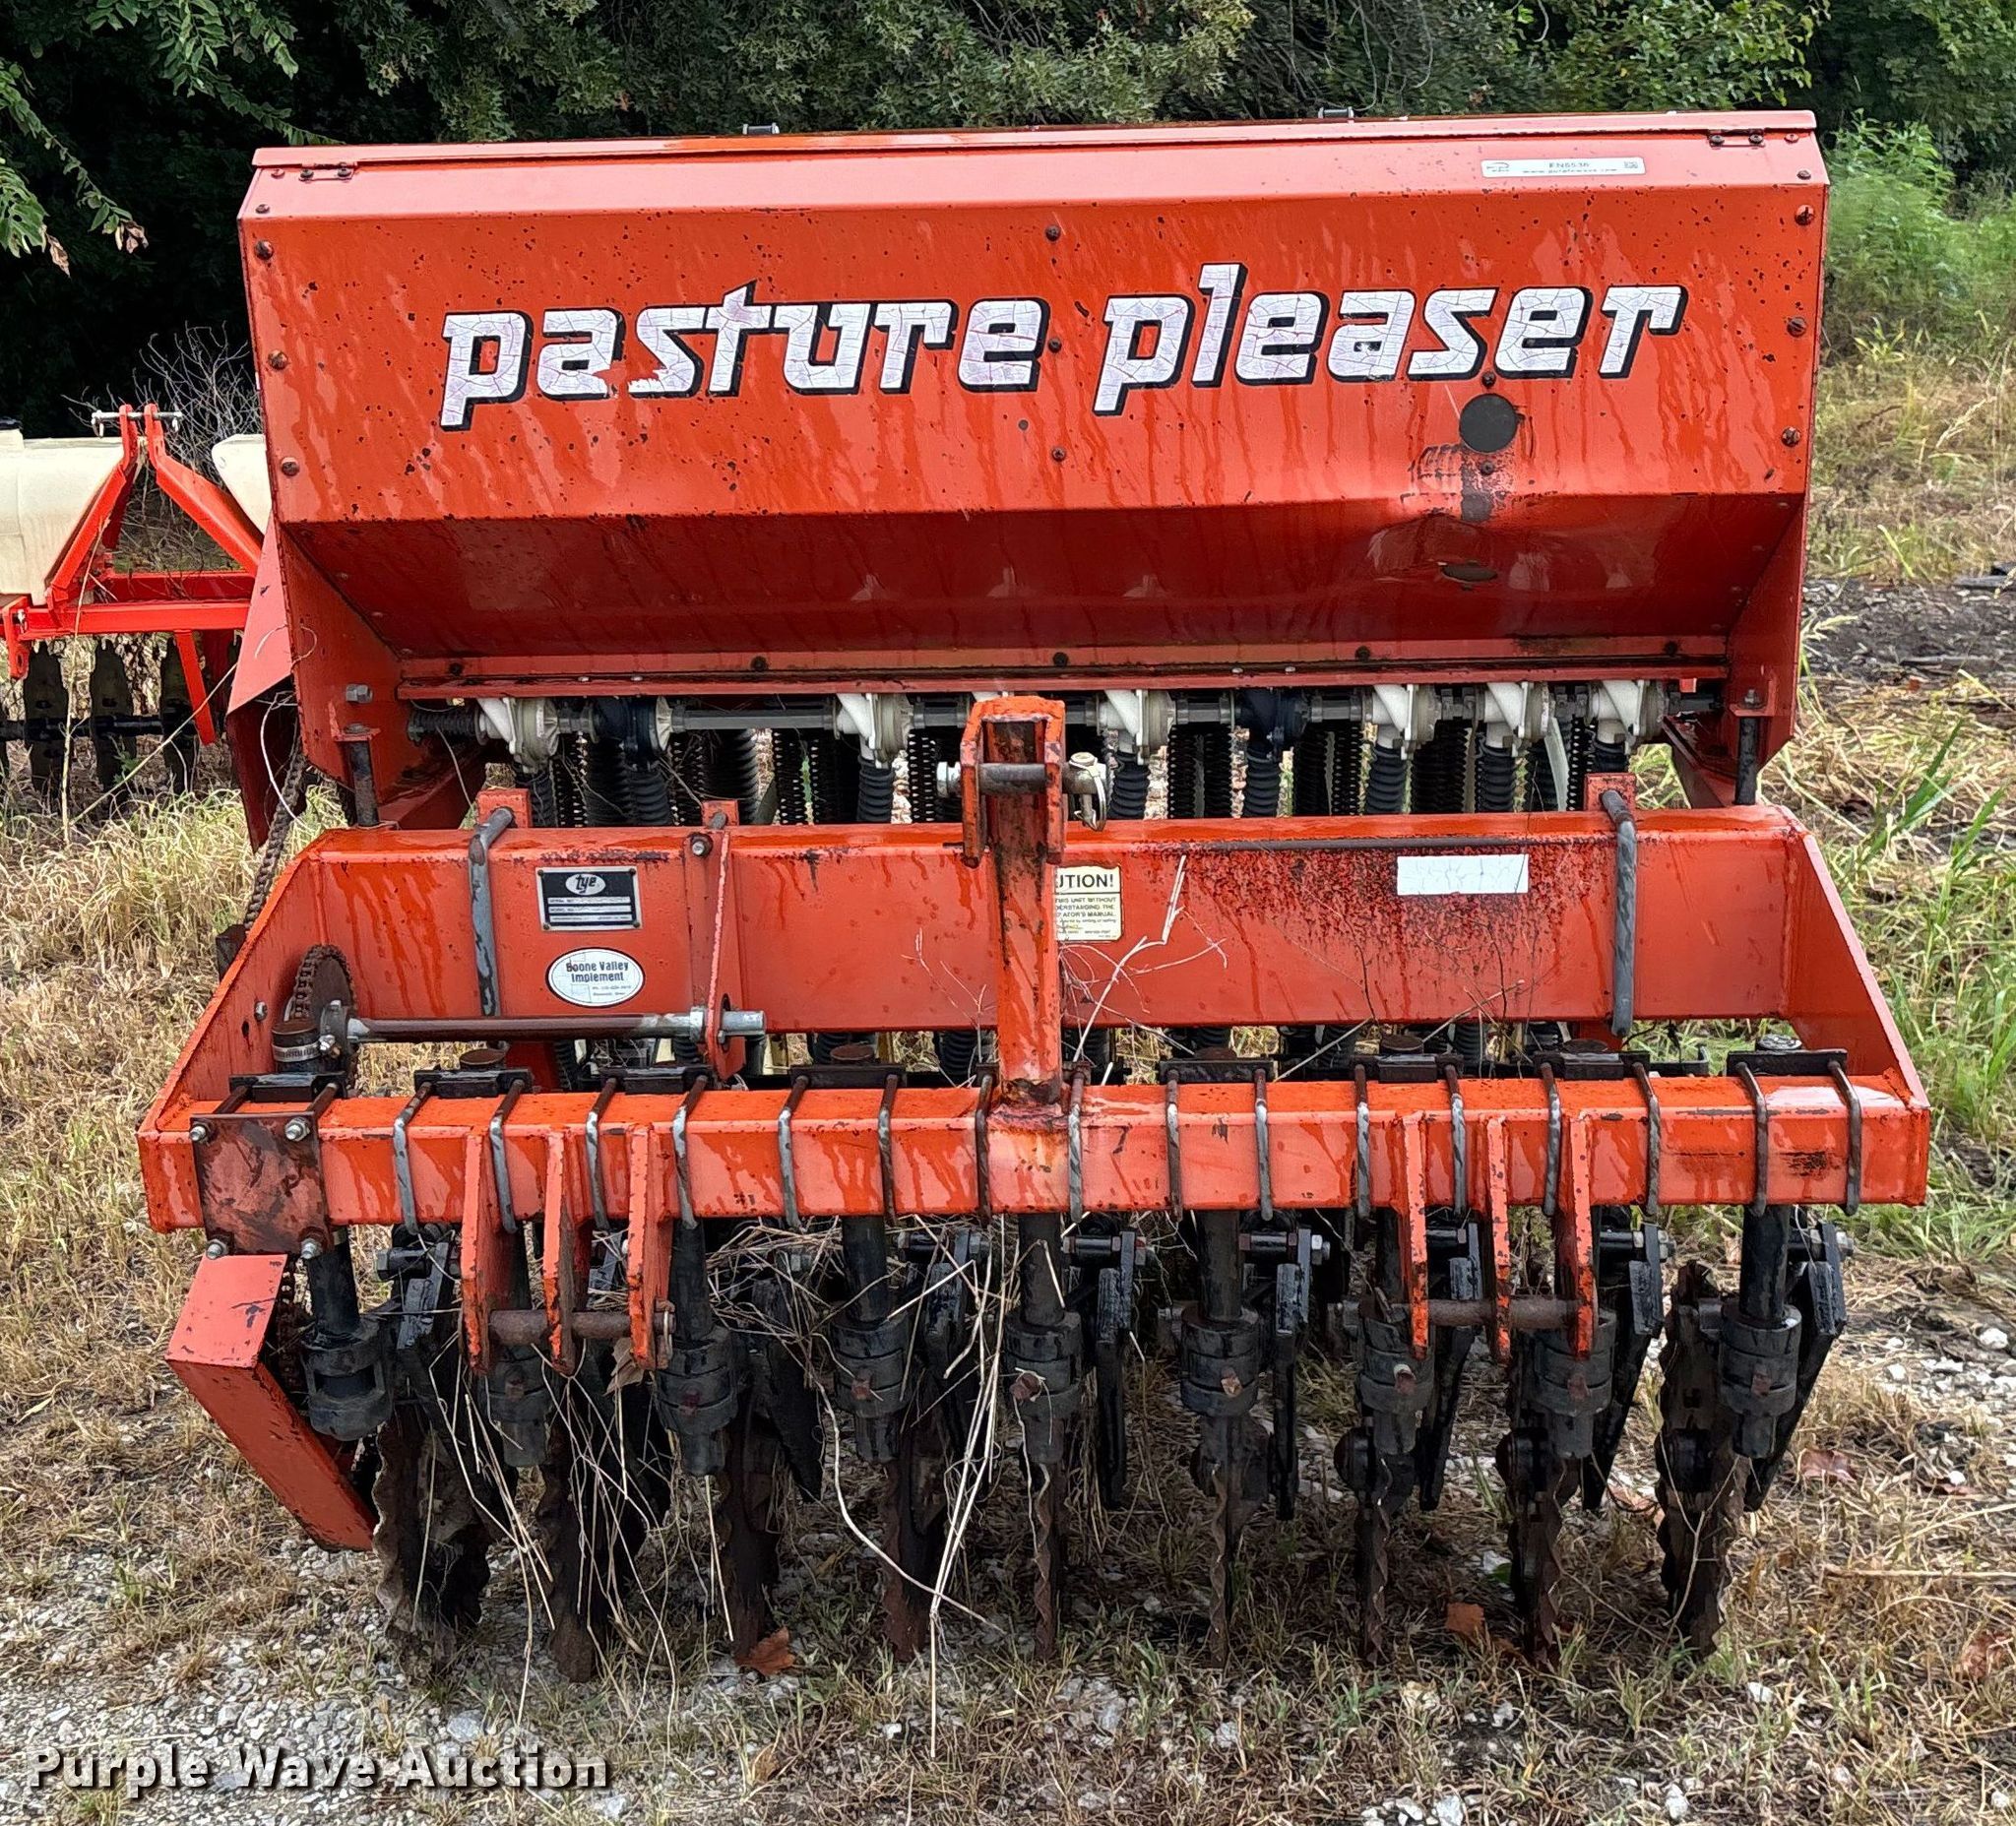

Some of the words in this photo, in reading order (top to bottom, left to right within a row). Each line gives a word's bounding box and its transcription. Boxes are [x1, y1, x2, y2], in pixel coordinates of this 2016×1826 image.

[439, 278, 1051, 431] pasture
[1093, 262, 1689, 417] pleaser
[575, 874, 598, 894] tye
[566, 963, 597, 972] Boone
[599, 961, 629, 972] Valley
[571, 972, 624, 982] Implement
